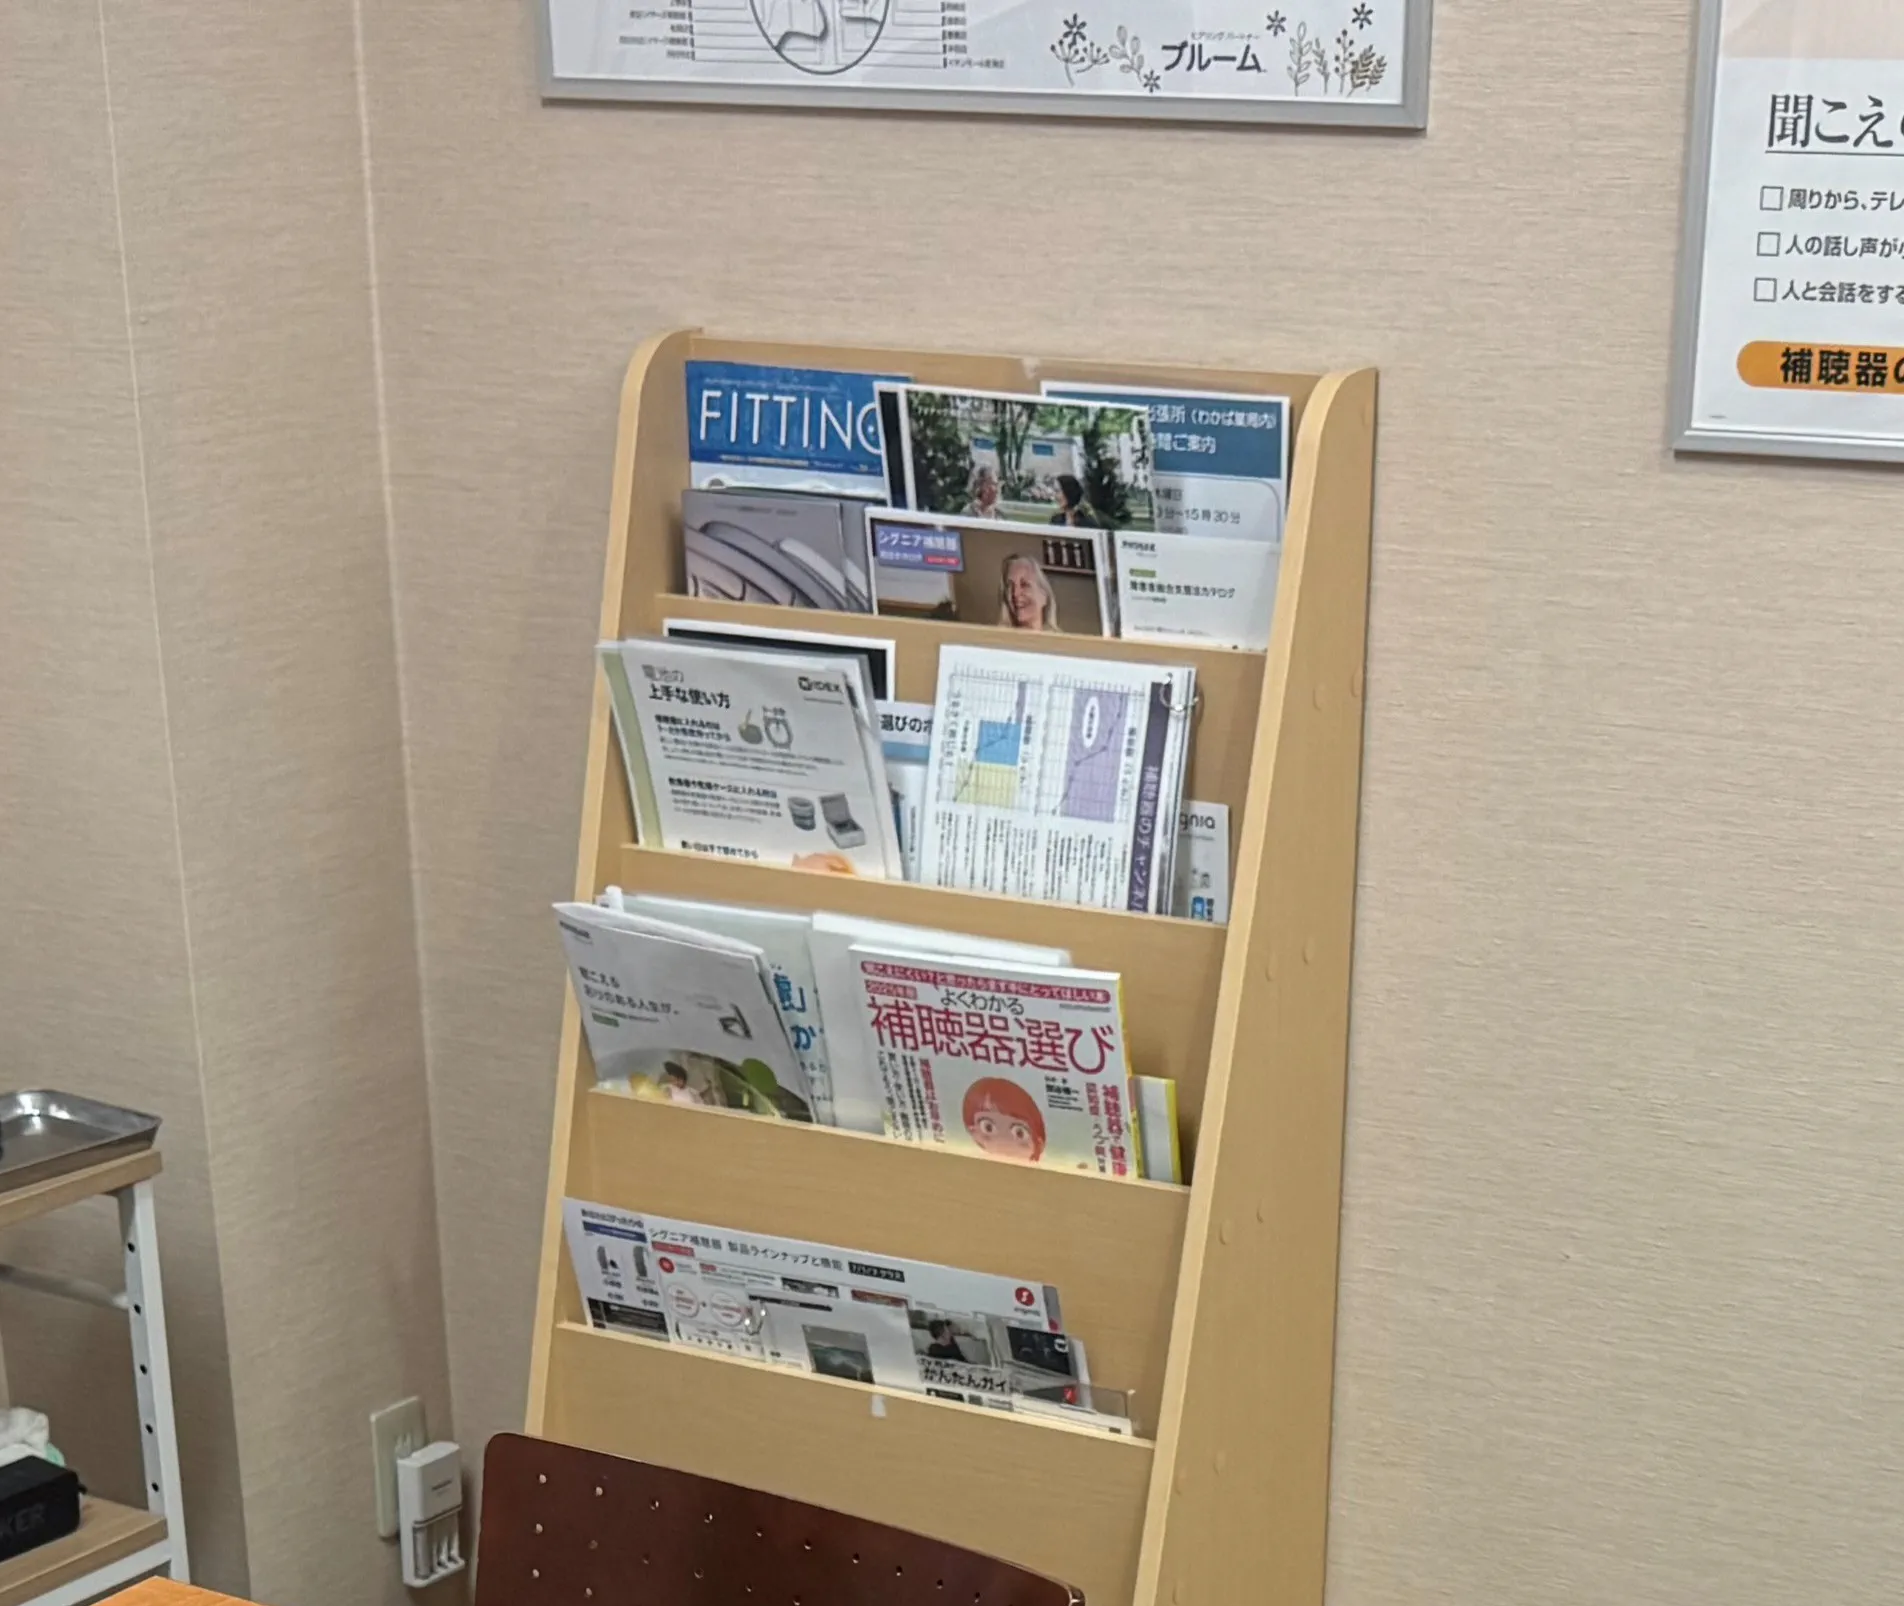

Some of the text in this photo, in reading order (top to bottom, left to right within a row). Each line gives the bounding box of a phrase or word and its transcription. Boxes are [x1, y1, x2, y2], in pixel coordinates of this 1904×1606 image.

[1161, 41, 1262, 73] ブルーム
[648, 683, 731, 709] 上手な使い方
[1180, 812, 1215, 831] gnia
[940, 988, 1025, 1016] よくわかる
[867, 996, 1116, 1075] 補聴器選び
[923, 1368, 1008, 1393] かんたんガイ
